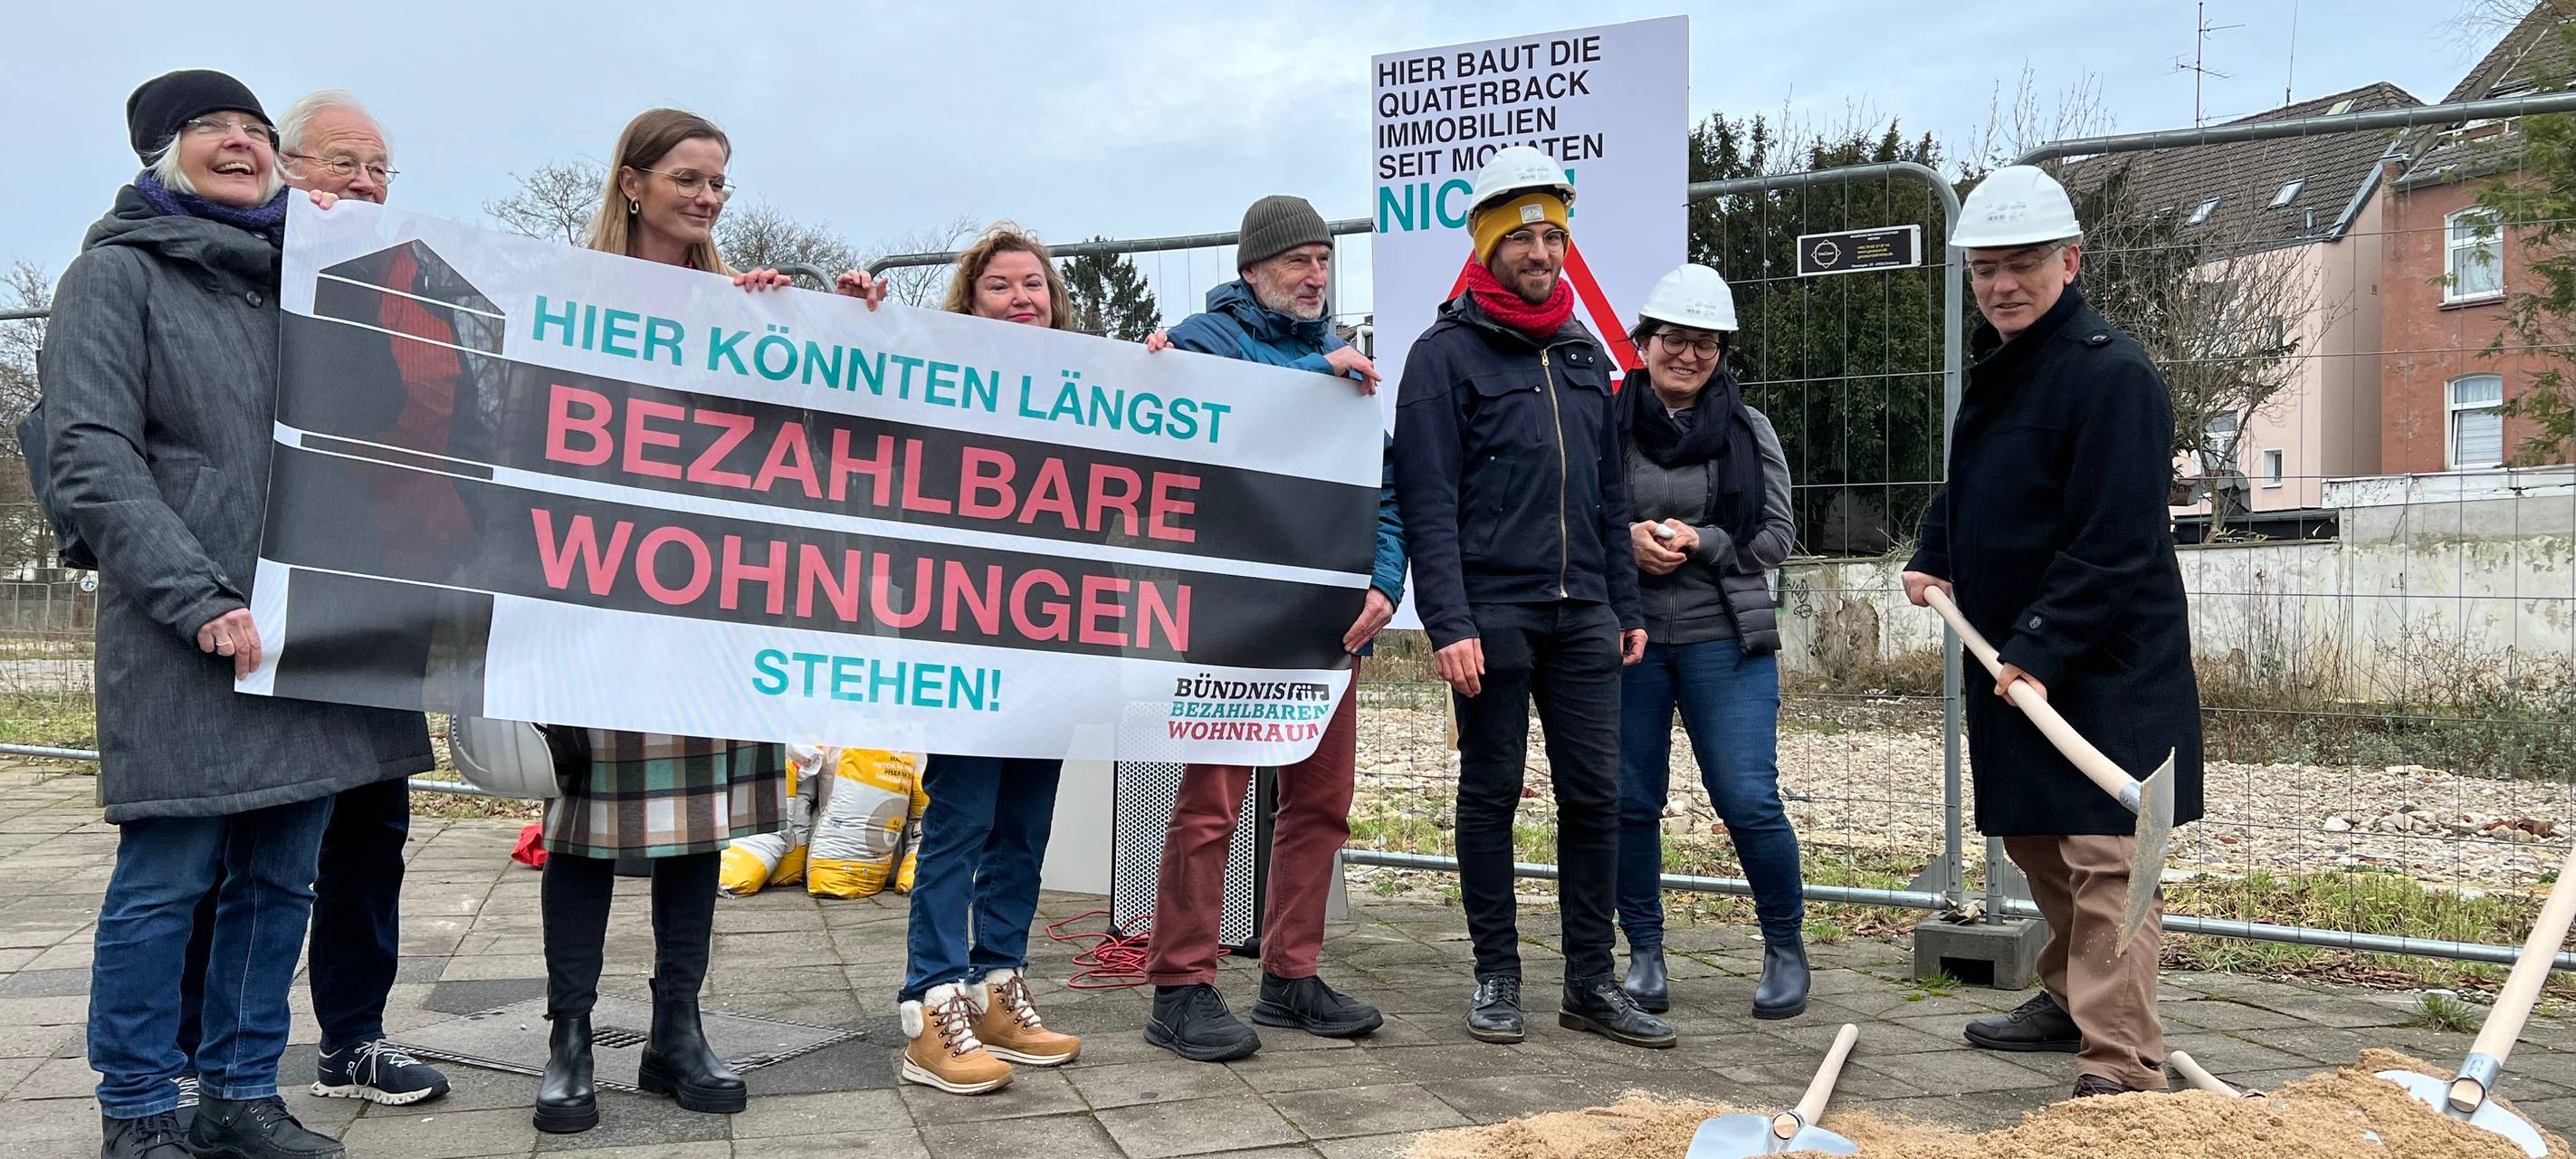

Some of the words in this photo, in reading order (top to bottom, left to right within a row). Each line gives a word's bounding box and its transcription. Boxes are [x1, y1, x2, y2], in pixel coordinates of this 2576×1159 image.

[1379, 55, 1445, 87] HIER
[1457, 43, 1540, 78] BAUT
[1550, 35, 1601, 66] DIE
[1379, 70, 1590, 118] QUATERBACK
[1379, 105, 1556, 149] IMMOBILIEN
[1379, 149, 1442, 179] SEIT
[1452, 132, 1603, 173] MOTEN
[532, 295, 685, 366] HIER
[707, 323, 999, 413] KÖNNTEN
[1018, 369, 1231, 444] LÄNGST
[545, 383, 1201, 543] BEZAHLBARE
[530, 508, 1193, 652] WOHNUNGEN
[752, 648, 1002, 713] STEHEN!
[1175, 673, 1286, 700] BÜNDNIS
[1289, 684, 1327, 701] für
[1170, 701, 1330, 721] BEZAHLBAREN
